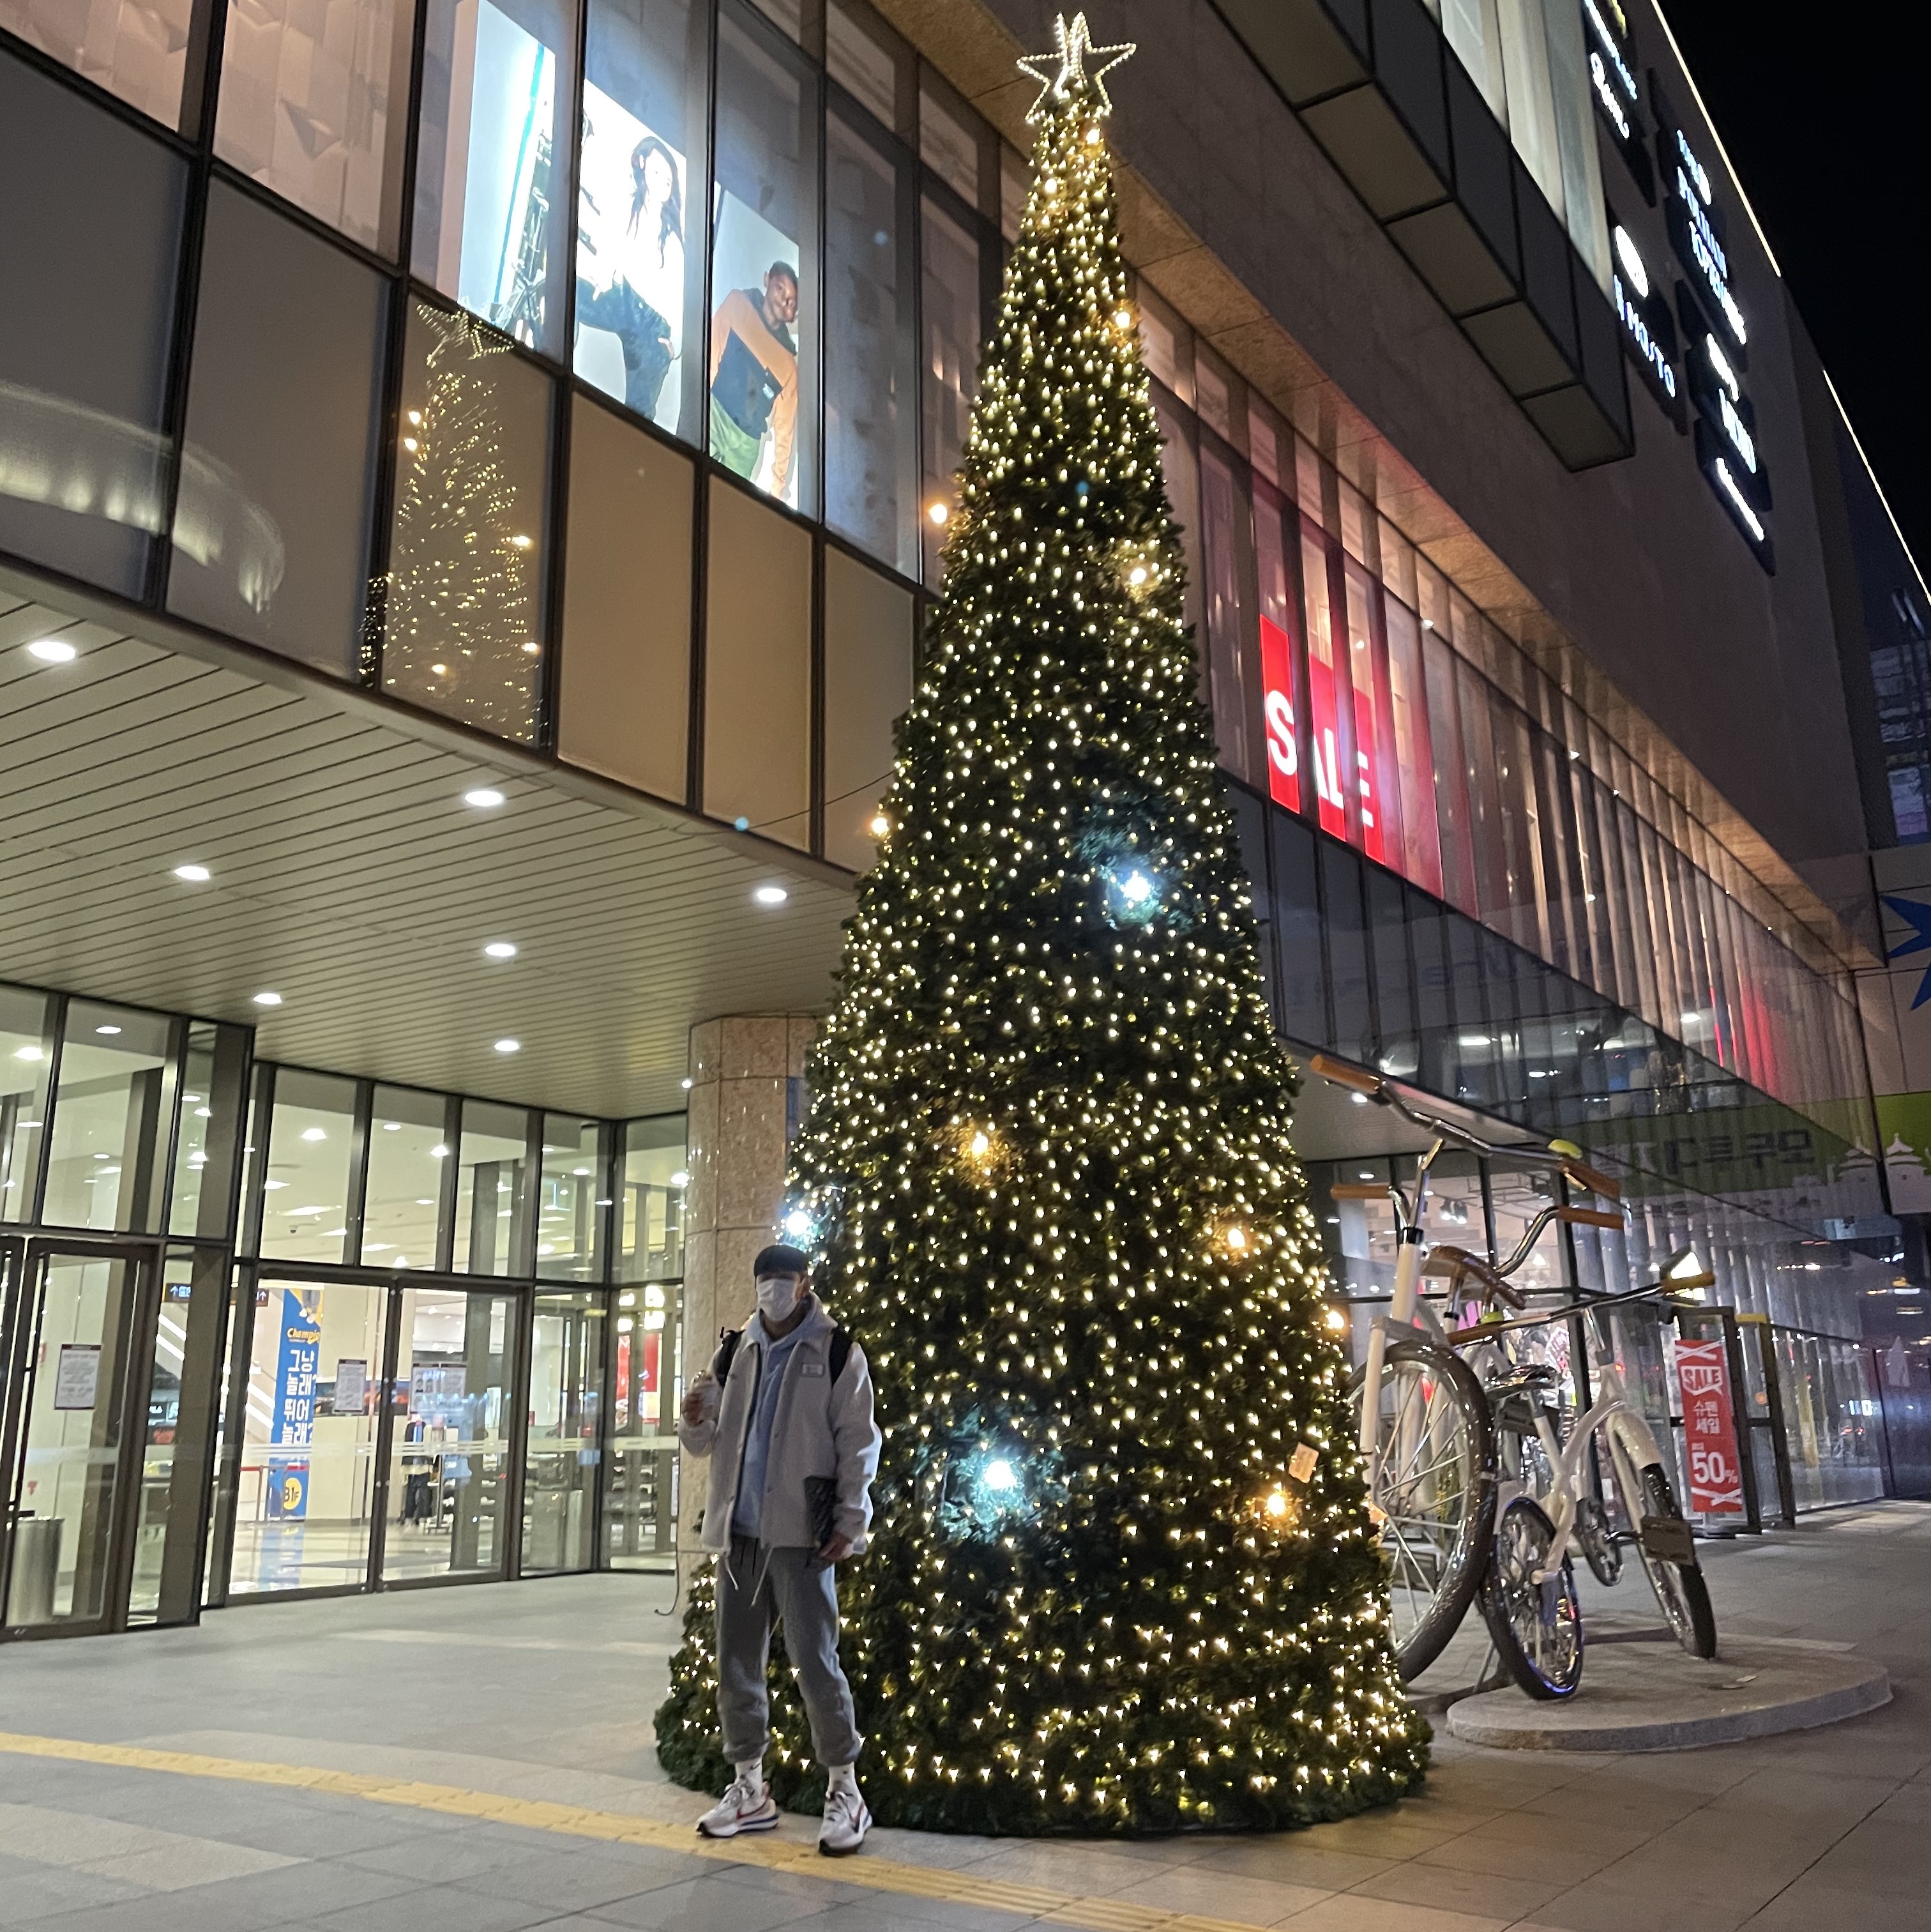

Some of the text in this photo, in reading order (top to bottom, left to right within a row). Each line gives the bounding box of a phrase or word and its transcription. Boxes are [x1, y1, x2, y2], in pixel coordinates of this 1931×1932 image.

[287, 1349, 315, 1373] 그냥
[284, 1398, 310, 1422] 뛰어
[1691, 1452, 1739, 1484] 50%
